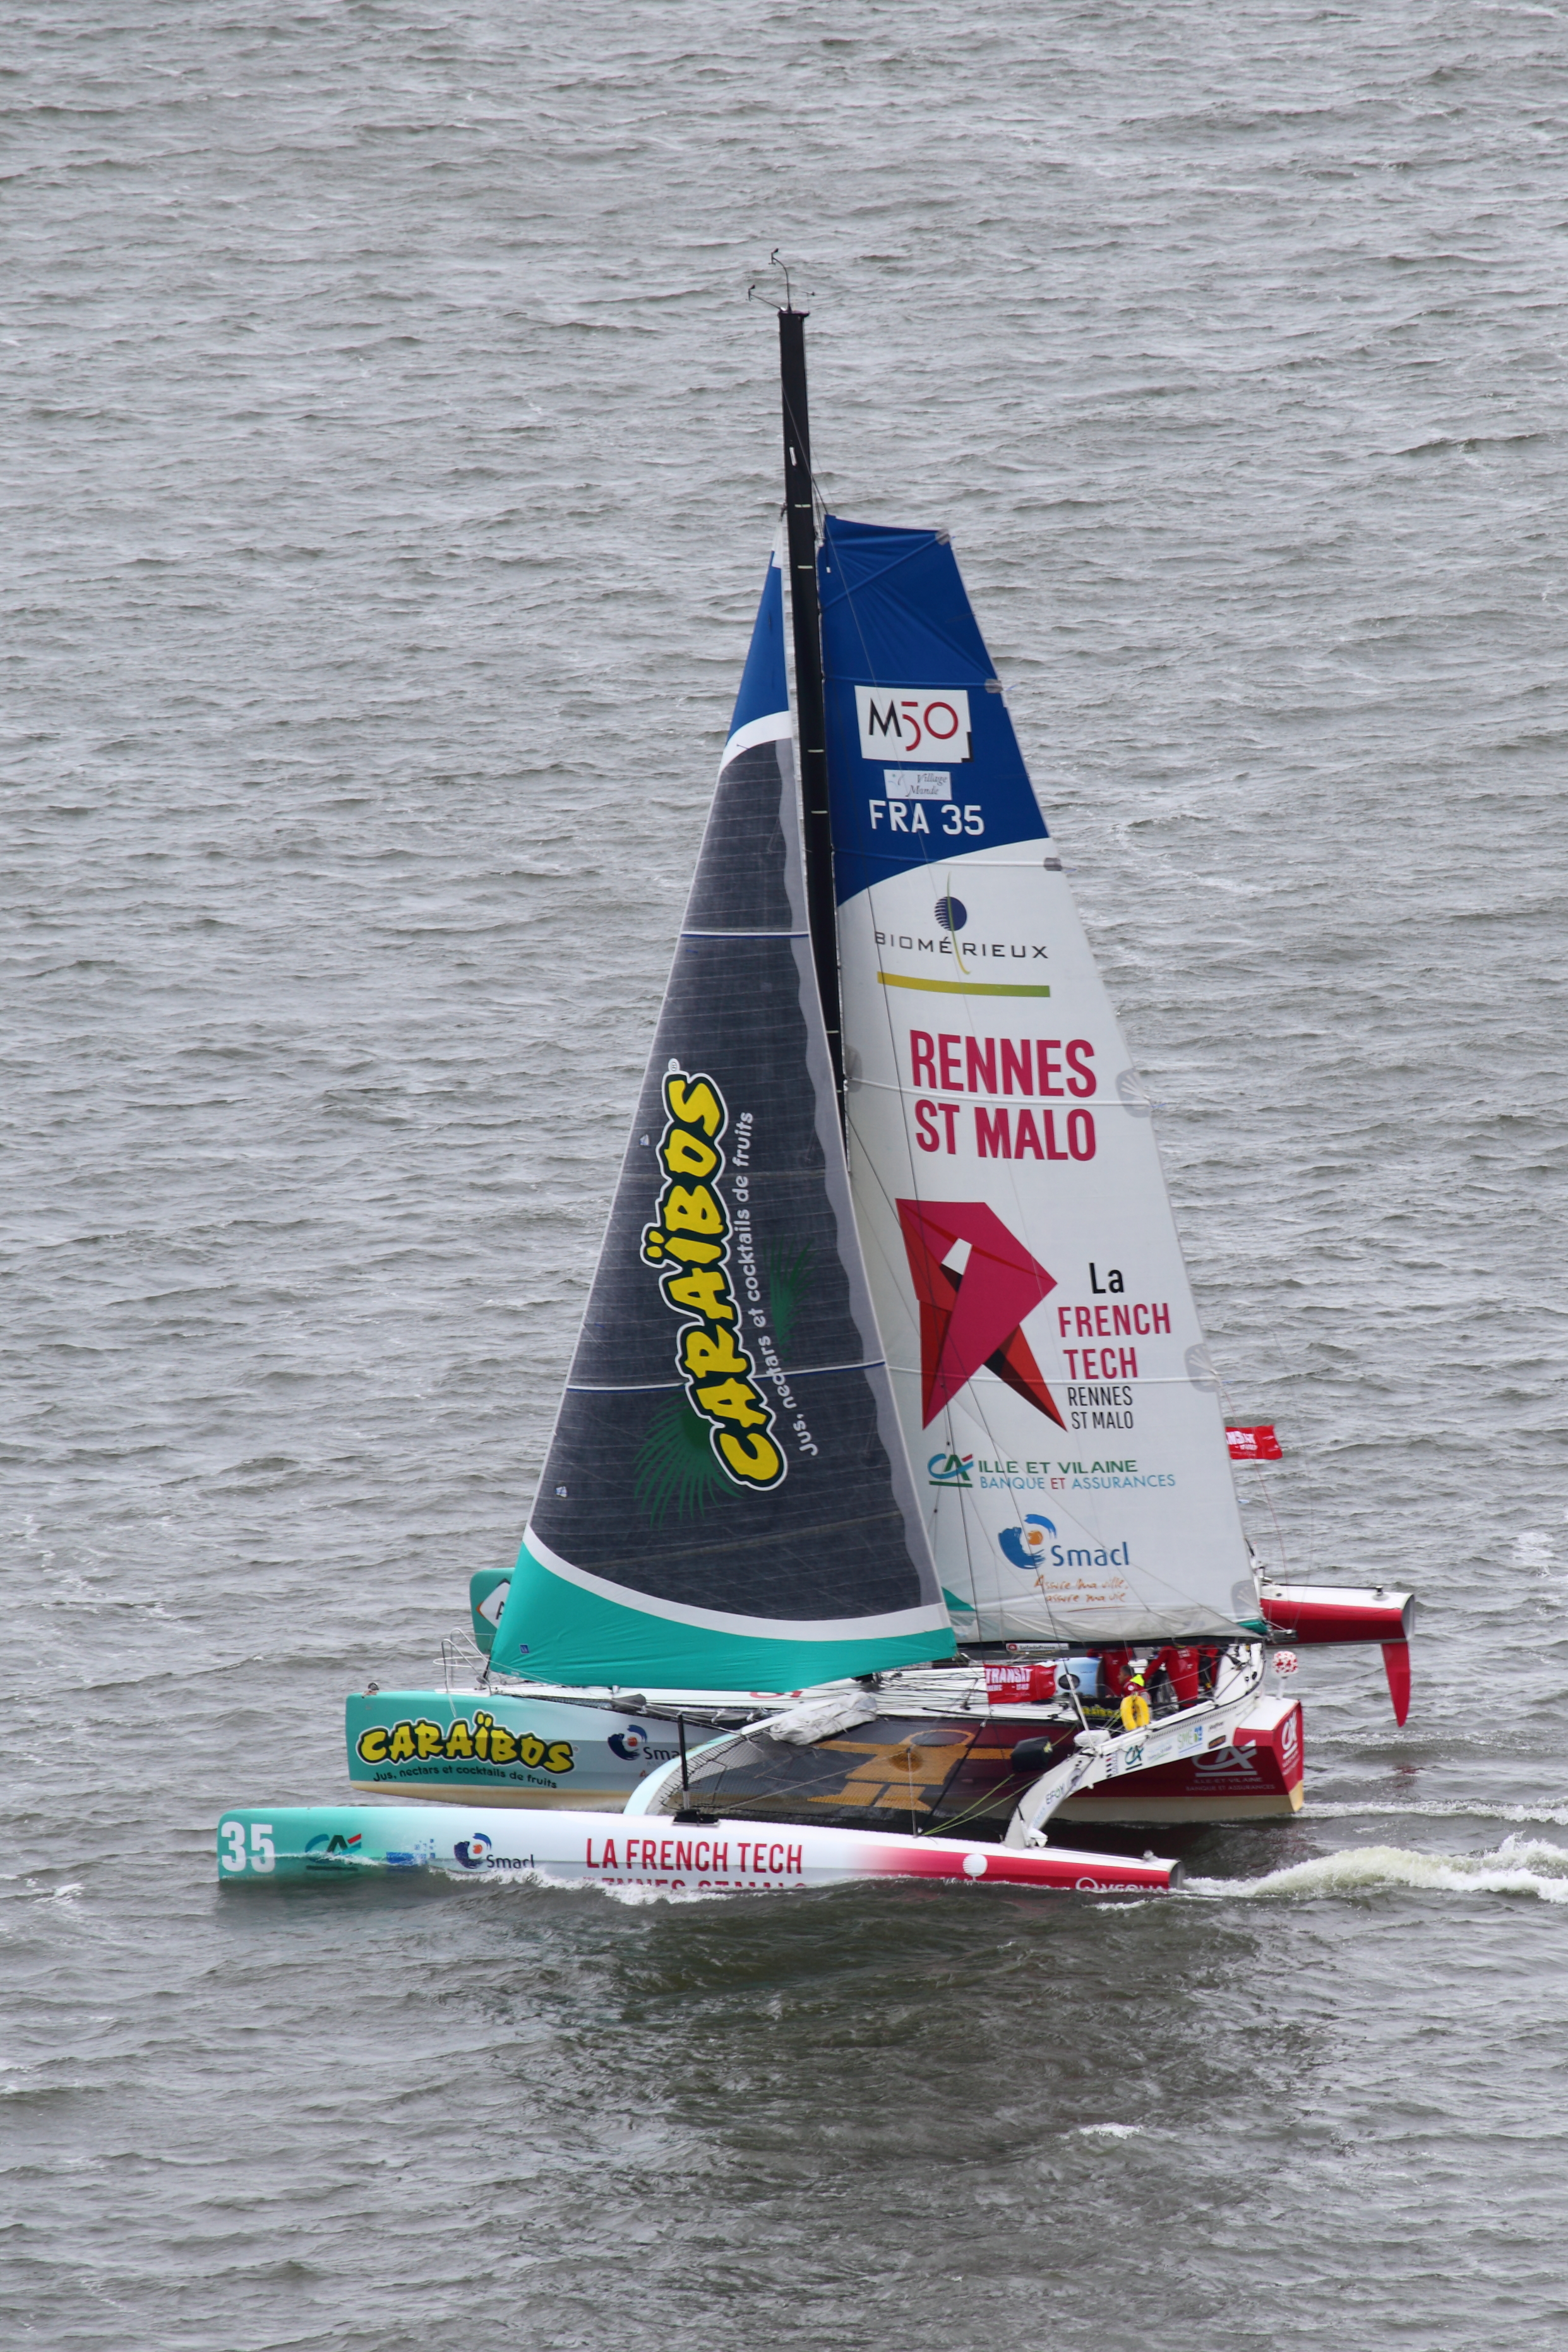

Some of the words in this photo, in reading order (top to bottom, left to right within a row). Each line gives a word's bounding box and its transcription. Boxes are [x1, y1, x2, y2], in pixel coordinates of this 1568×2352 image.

[868, 698, 959, 752] M50
[917, 773, 947, 786] Village
[869, 799, 930, 834] FRA
[941, 804, 984, 836] 35
[875, 931, 1049, 959] BIOMÉRIEUX
[909, 1029, 1097, 1098] RENNES
[732, 1112, 753, 1167] fruits
[914, 1099, 961, 1155] ST
[974, 1106, 1097, 1161] MALO
[732, 1175, 749, 1203] de
[734, 1209, 762, 1302] cocktails
[642, 1074, 786, 1487] CARAÏBOS
[1089, 1263, 1125, 1295] La
[748, 1309, 767, 1328] et
[1057, 1303, 1171, 1338] FRENCH
[758, 1335, 798, 1409] nectars
[1063, 1347, 1139, 1380] TECH
[1067, 1386, 1133, 1407] RENNES
[793, 1413, 818, 1456] Jus,
[1071, 1411, 1090, 1429] ST
[1092, 1411, 1134, 1430] MALO
[978, 1460, 1019, 1473] ILLE
[1026, 1461, 1051, 1474] ET
[1057, 1460, 1138, 1474] VILAINE
[980, 1476, 1045, 1490] BANQUE
[1050, 1477, 1066, 1490] ET
[1072, 1474, 1176, 1490] ASSURANCES
[1051, 1541, 1129, 1566] Smacl
[357, 1710, 575, 1773] CARAÏBOS
[373, 1772, 397, 1782] Jus,
[399, 1766, 440, 1777] nectars
[443, 1765, 453, 1774] et
[456, 1766, 506, 1778] cocktails
[509, 1771, 524, 1781] de
[527, 1775, 557, 1789] fruits
[221, 1821, 275, 1873] 35
[586, 1839, 618, 1869] LA
[626, 1839, 728, 1871] FRENCH
[738, 1842, 803, 1874] TECH
